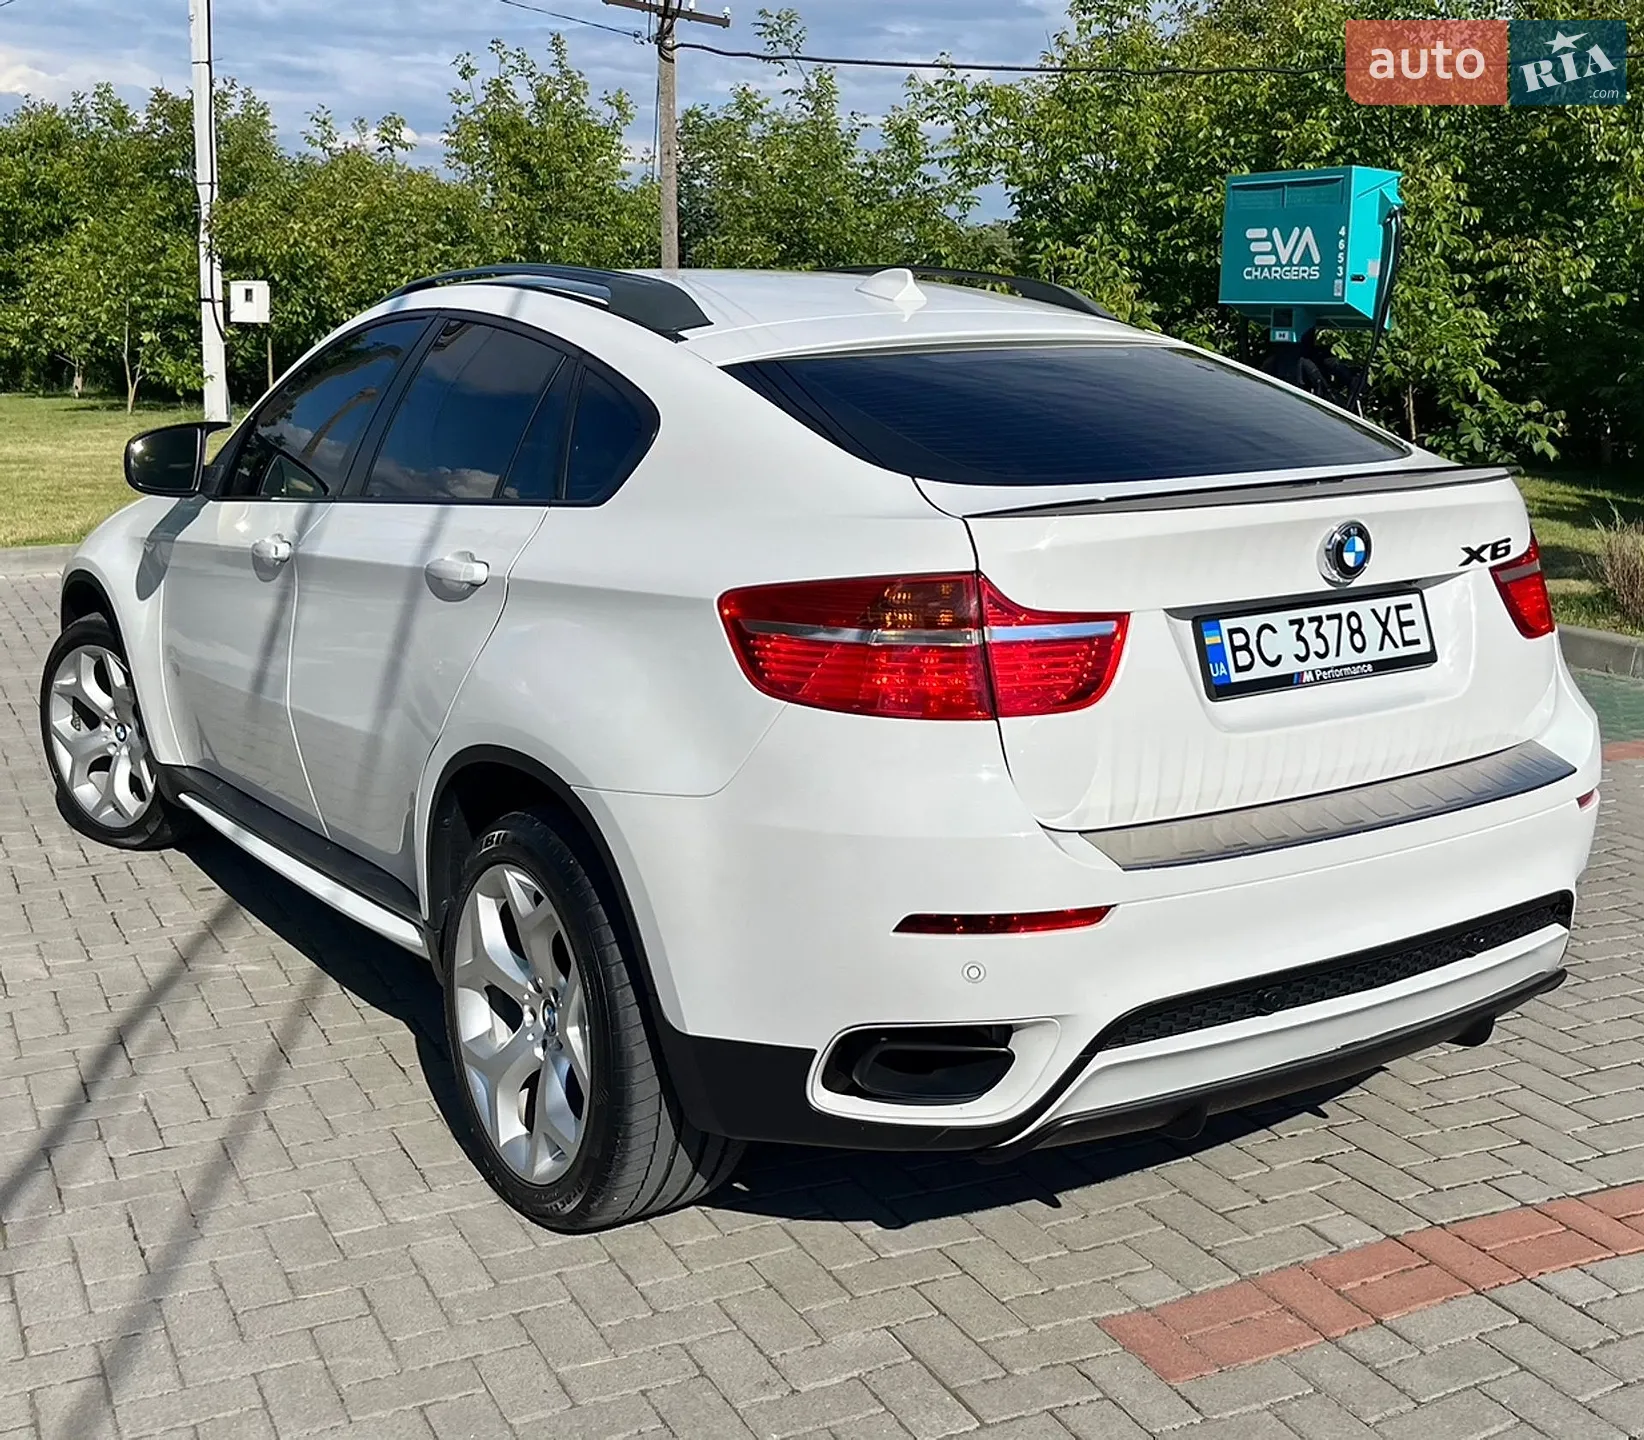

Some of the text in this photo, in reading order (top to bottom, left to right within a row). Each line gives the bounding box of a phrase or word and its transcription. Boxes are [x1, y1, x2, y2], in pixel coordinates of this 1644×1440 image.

[1245, 226, 1321, 265] EVA
[1243, 266, 1321, 280] CHARGERS
[1458, 537, 1512, 567] X6
[1227, 603, 1421, 673] BC 3378 XE
[1210, 662, 1228, 677] UA
[1315, 664, 1374, 681] Performance
